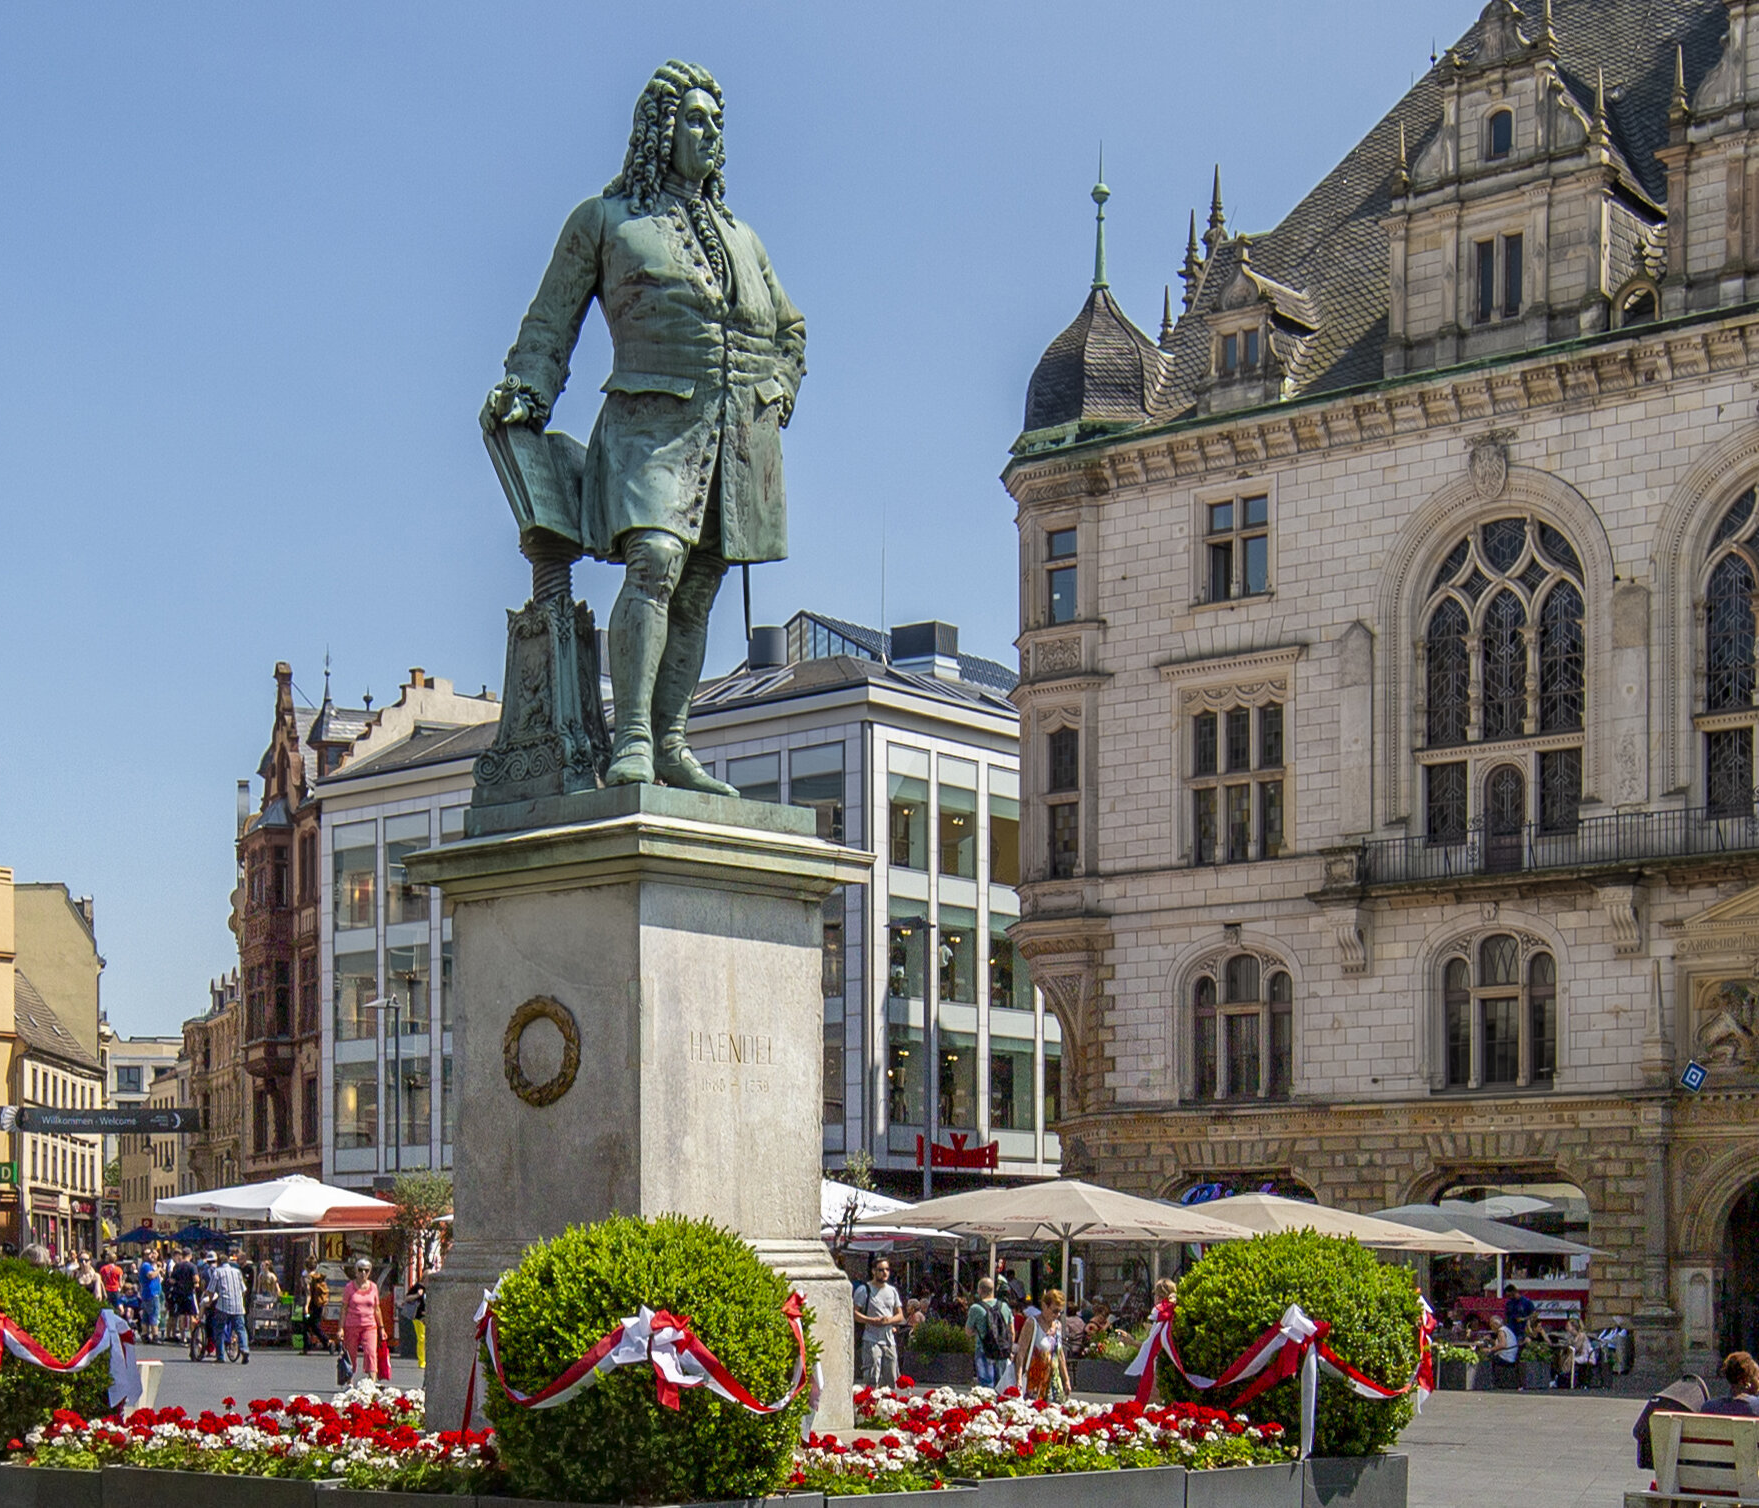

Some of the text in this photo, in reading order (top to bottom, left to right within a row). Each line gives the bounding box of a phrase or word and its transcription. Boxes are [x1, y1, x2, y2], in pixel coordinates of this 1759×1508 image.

[690, 1031, 778, 1065] HAENDEL
[41, 1115, 137, 1126] Willkommen Welcome
[1, 1165, 12, 1180] D
